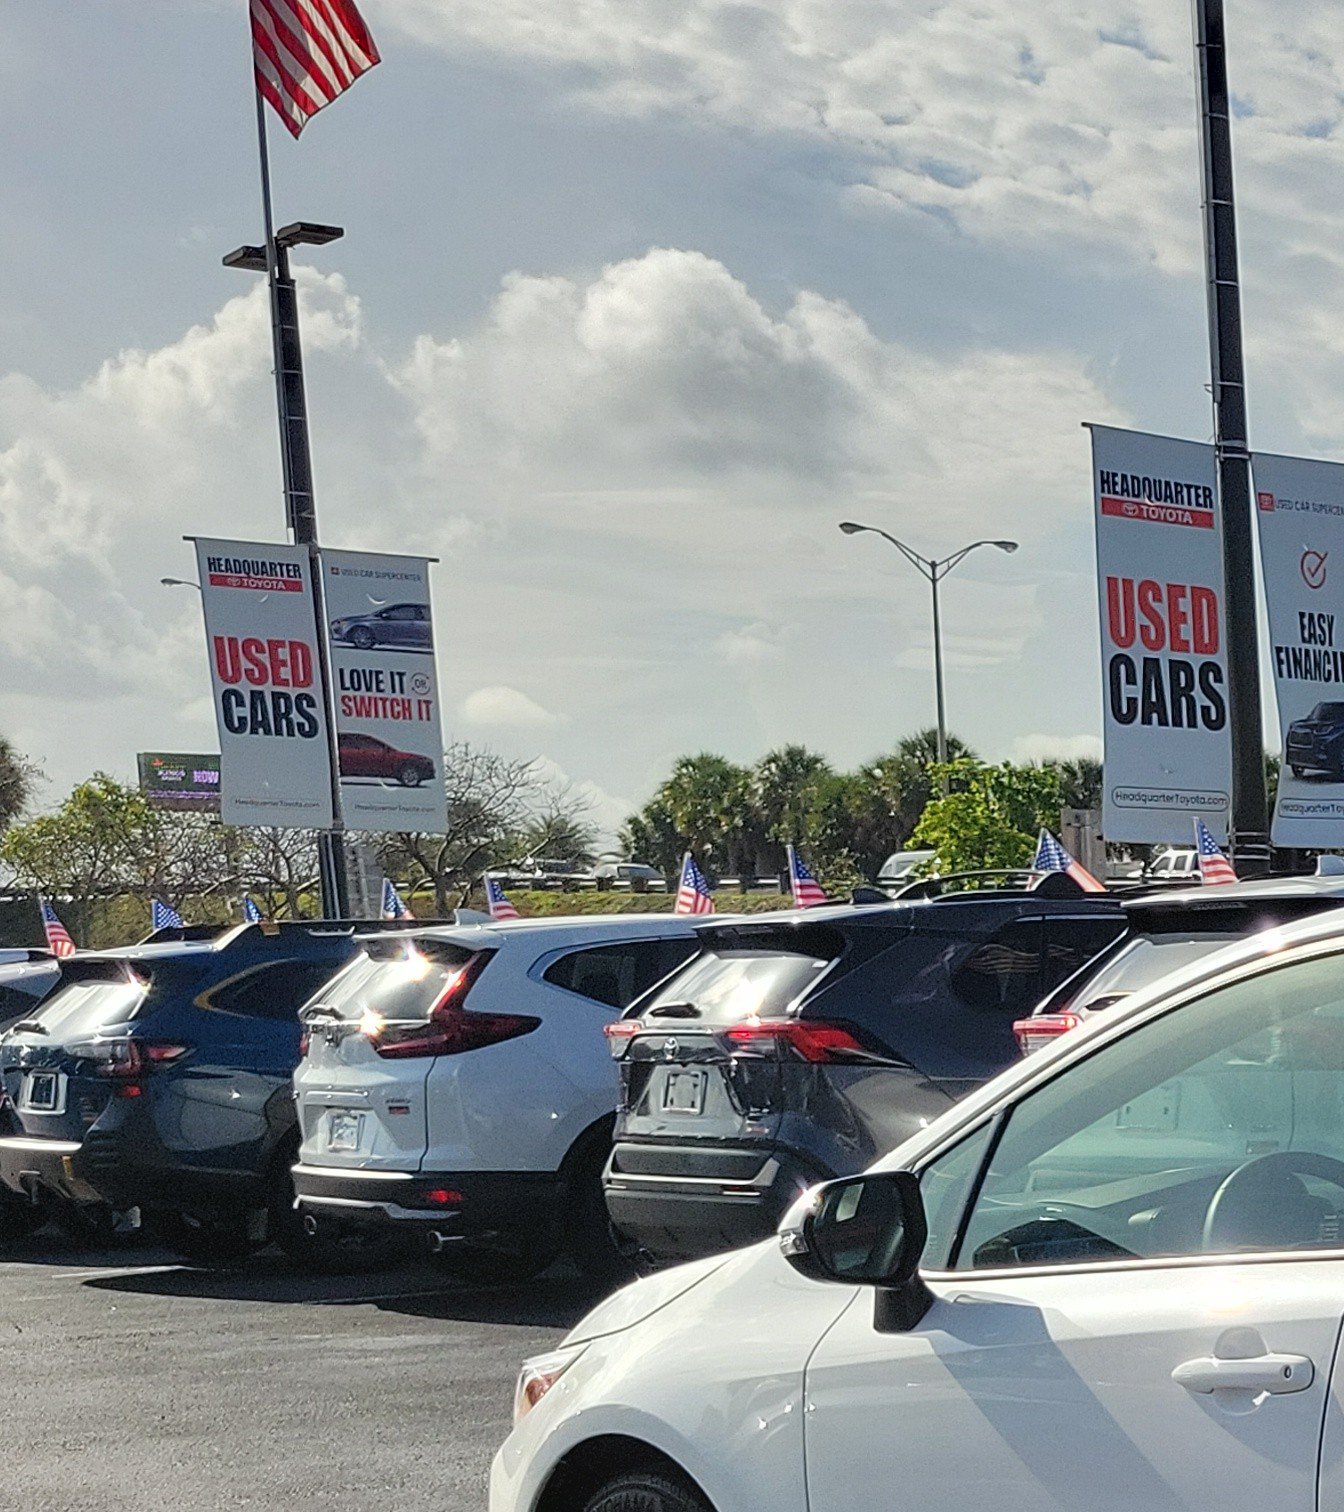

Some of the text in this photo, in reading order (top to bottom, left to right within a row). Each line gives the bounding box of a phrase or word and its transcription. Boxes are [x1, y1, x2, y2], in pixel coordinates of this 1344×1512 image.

[1099, 469, 1214, 509] HEADQUARTER
[1141, 505, 1193, 525] TOYOTA
[207, 556, 302, 579] HEADQUARTER
[242, 579, 287, 591] TOYOTA
[1106, 576, 1219, 655] USED
[1298, 611, 1334, 647] EASY
[213, 635, 314, 688] USED
[339, 667, 406, 694] LOVE IT
[1109, 652, 1227, 732] CARS
[221, 687, 320, 739] CARS
[340, 695, 433, 721] SWITCH IT
[1115, 791, 1227, 807] HeadquarterToyota.com
